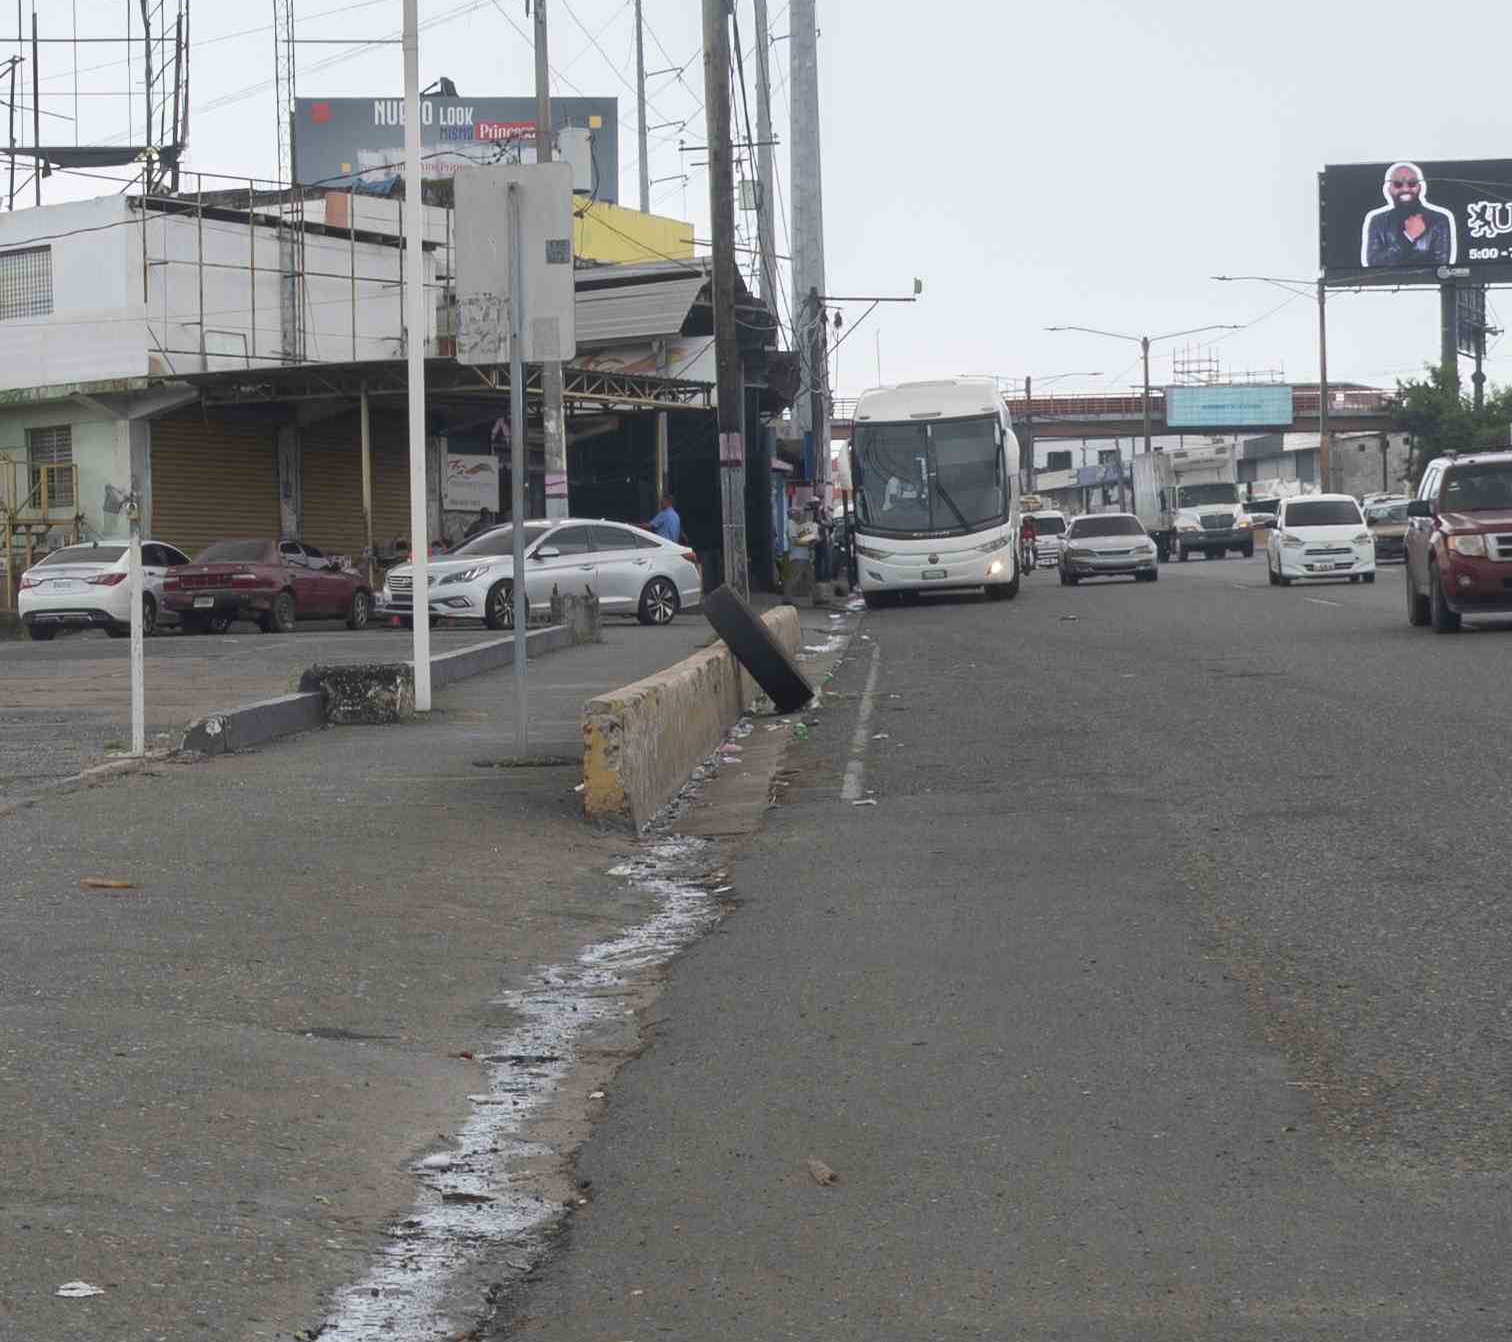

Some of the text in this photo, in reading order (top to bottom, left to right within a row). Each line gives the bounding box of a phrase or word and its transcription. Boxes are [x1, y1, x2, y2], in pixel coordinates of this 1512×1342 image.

[374, 100, 473, 126] NUEO LOOK
[1469, 247, 1498, 259] 5:00
